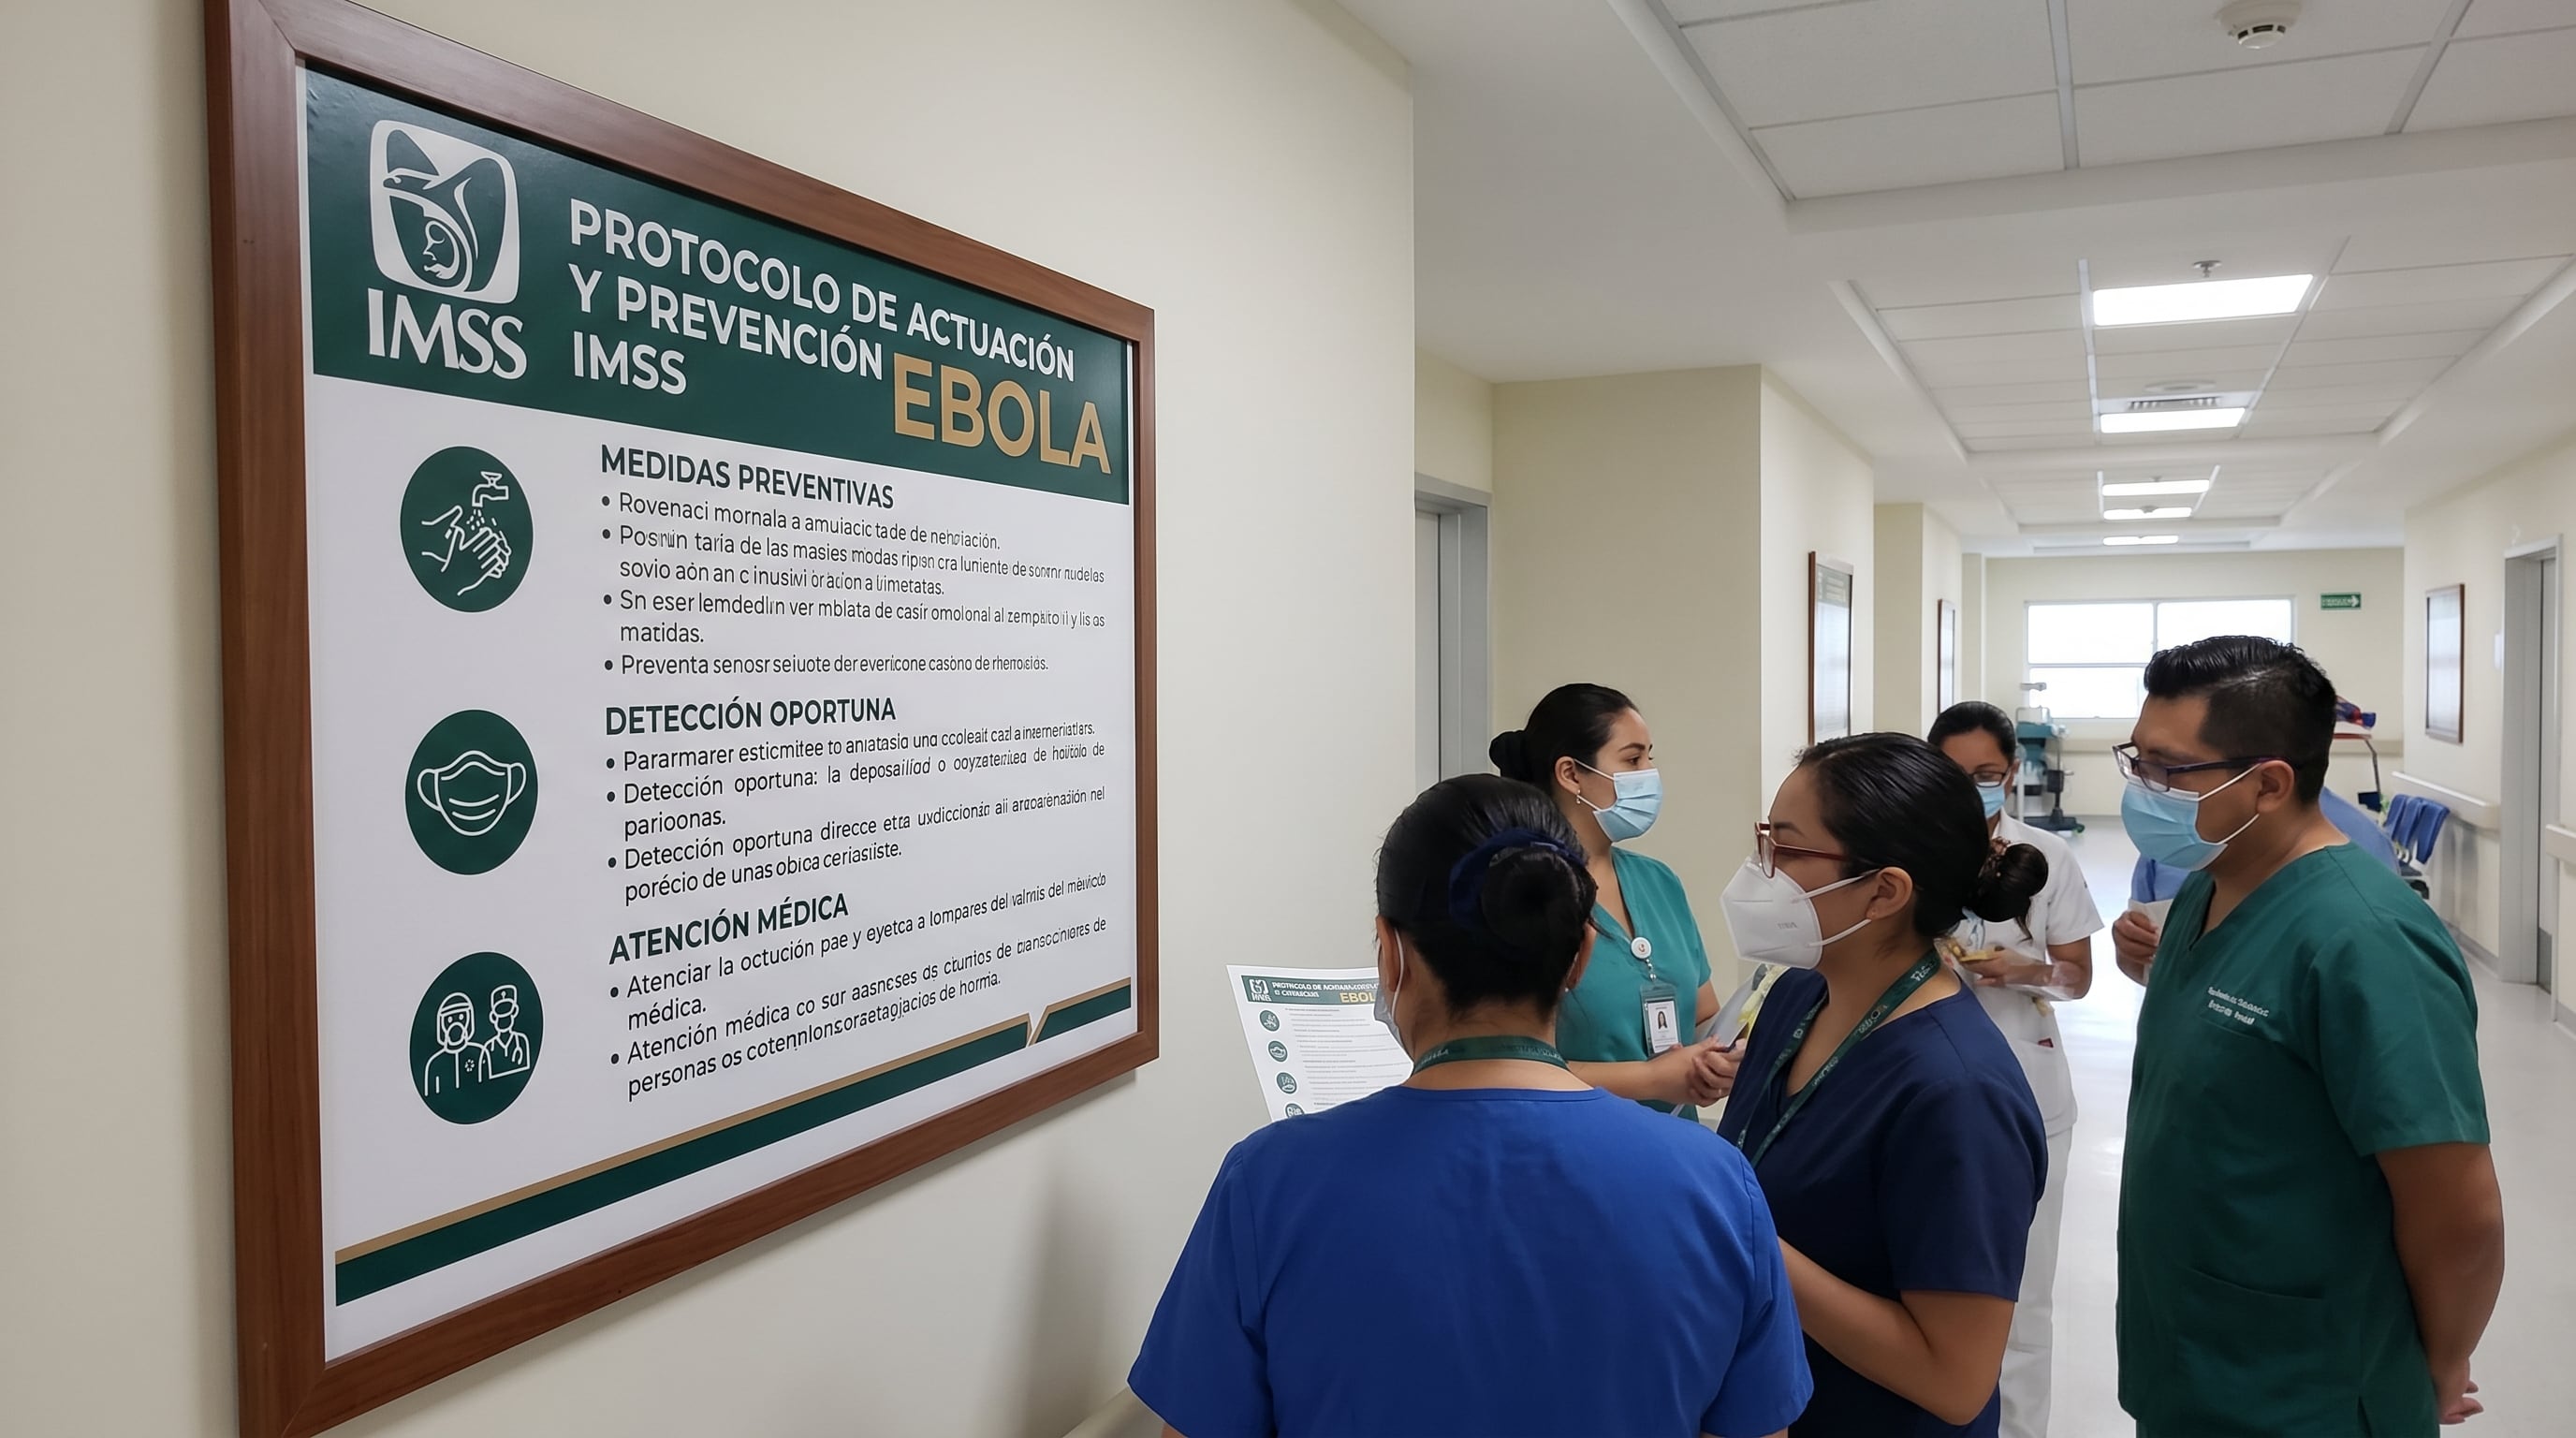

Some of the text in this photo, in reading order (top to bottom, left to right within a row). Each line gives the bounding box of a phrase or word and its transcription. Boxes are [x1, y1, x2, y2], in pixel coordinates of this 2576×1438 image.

[570, 198, 1076, 382] PROTOCOLO DE ACTUACIÓN
[368, 288, 527, 379] IMSS
[569, 264, 883, 380] Y PREVENCIÓN
[574, 331, 687, 395] IMSS
[892, 353, 1112, 474] EBOLA
[601, 445, 894, 508] MEDIDAS PREVENTIVAS
[620, 492, 709, 521] Rovenaci
[792, 516, 800, 530] a
[910, 525, 927, 543] de
[620, 559, 670, 578] sovio
[713, 568, 735, 582] an
[740, 536, 762, 555] de
[767, 537, 788, 557] las
[794, 542, 847, 562] masies
[1013, 561, 1026, 577] de
[621, 590, 646, 609] Sn
[652, 594, 695, 611] eser
[790, 602, 813, 616] ver
[875, 602, 892, 618] de
[994, 608, 1004, 623] al
[621, 622, 704, 643] matidas.
[622, 655, 709, 674] Preventa
[975, 656, 989, 671] de
[607, 696, 896, 735] DETECCIÓN OPORTUNA
[624, 748, 734, 770] Pararmarer
[828, 739, 842, 755] to
[624, 775, 723, 803] Detección
[735, 770, 818, 797] oportuna:
[828, 765, 841, 784] la
[938, 758, 945, 772] o
[1033, 746, 1046, 762] de
[1093, 741, 1105, 756] de
[624, 809, 725, 841] parioonas.
[624, 837, 723, 869] Detección
[733, 829, 812, 857] oportuna
[821, 821, 876, 841] direcce
[1090, 786, 1105, 800] nel
[625, 874, 698, 906] porécio
[703, 868, 726, 888] de
[731, 863, 772, 884] unas
[776, 857, 819, 876] obica
[609, 892, 849, 964] ATENCIÓN MÉDICA
[627, 963, 710, 998] Atenciar
[719, 957, 734, 977] la
[740, 941, 814, 971] octución
[821, 932, 848, 956] pae
[853, 931, 861, 949] y
[917, 916, 926, 929] a
[929, 901, 988, 928] lompares
[990, 894, 1008, 912] del
[1048, 881, 1064, 898] del
[627, 1023, 717, 1064] Atención
[725, 1005, 789, 1037] médica
[797, 999, 814, 1017] co
[997, 943, 1012, 960] de
[1093, 917, 1106, 932] de
[628, 997, 706, 1031] médica.
[1339, 992, 1376, 1003] EBOL
[629, 1056, 716, 1102] personas
[722, 1049, 741, 1069] os
[940, 984, 956, 1002] de
